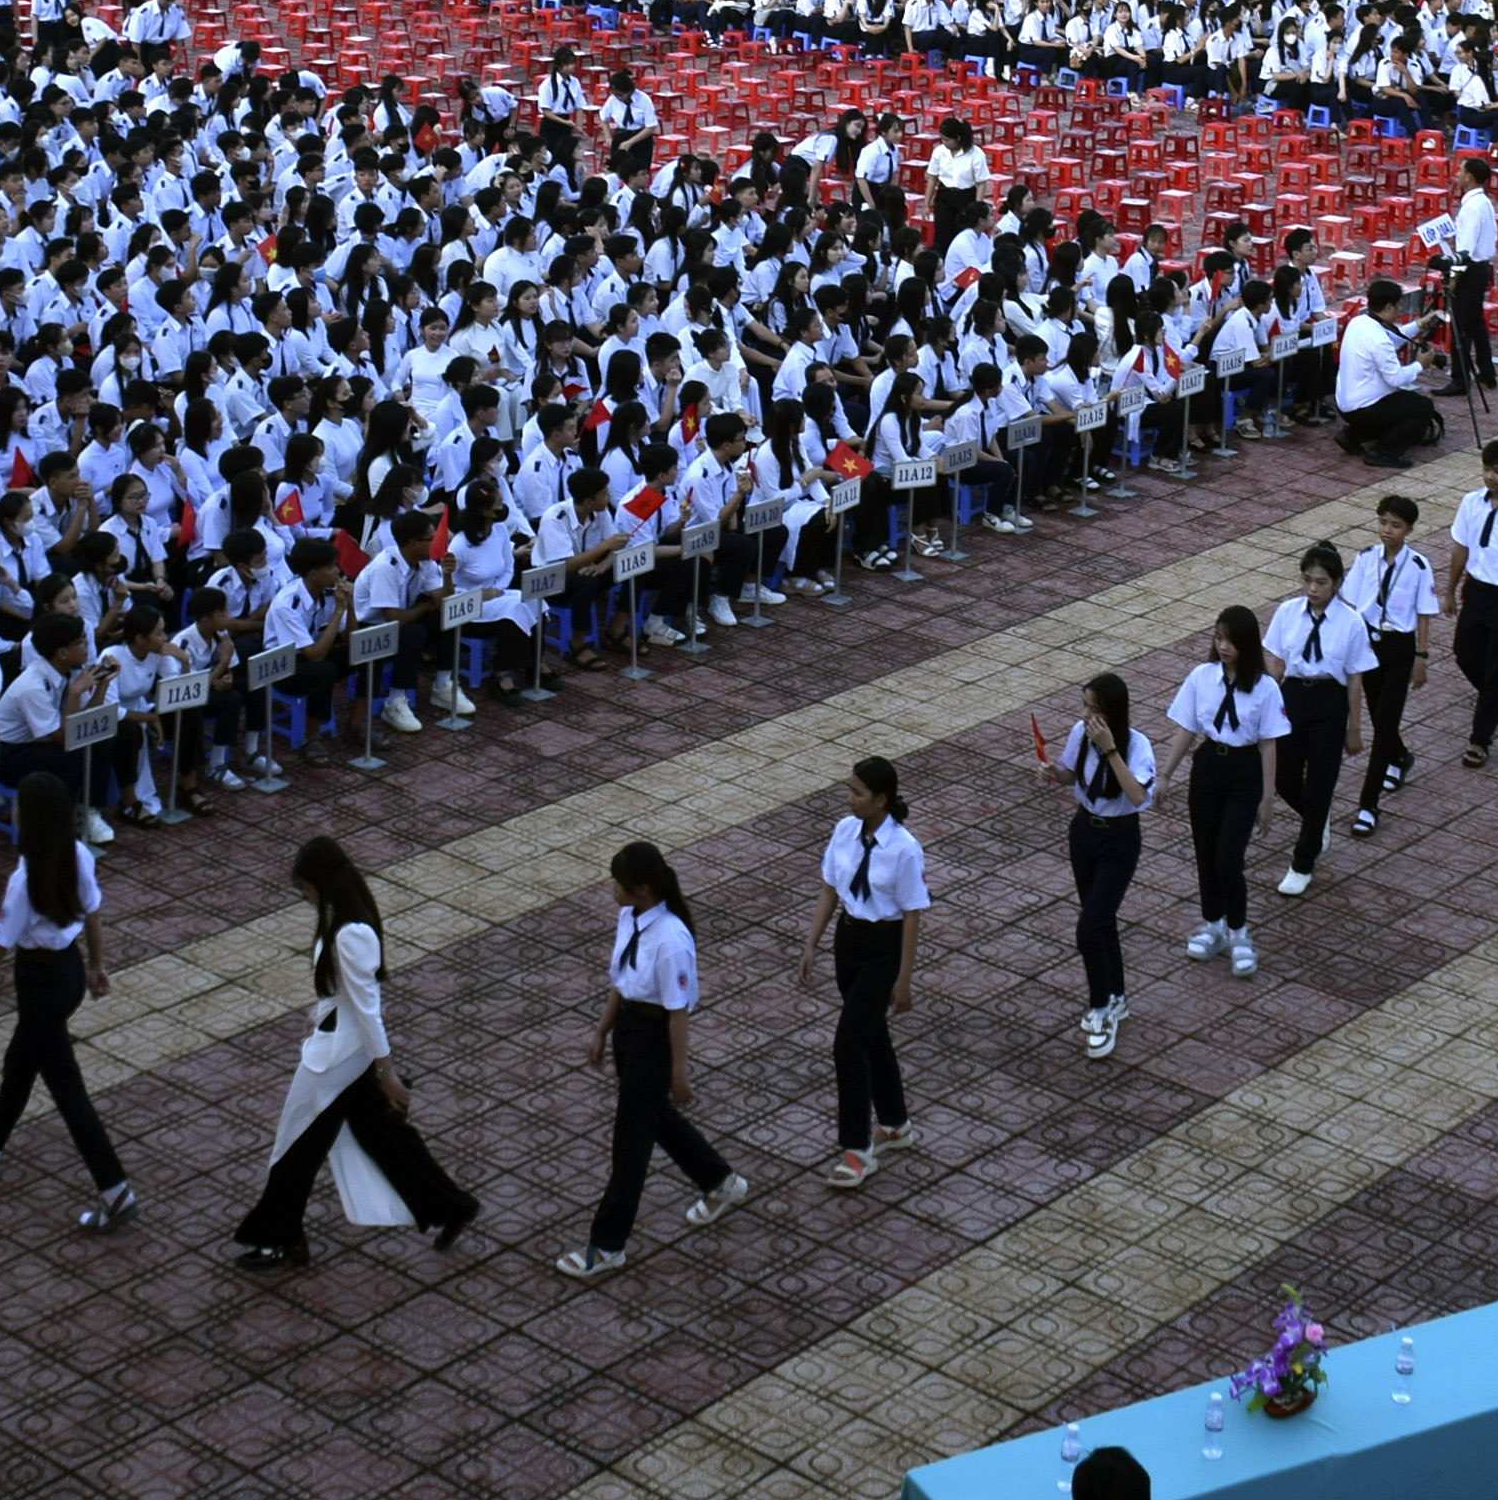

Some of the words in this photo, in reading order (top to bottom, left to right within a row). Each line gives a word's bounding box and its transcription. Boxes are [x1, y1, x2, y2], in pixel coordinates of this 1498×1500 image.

[1181, 374, 1202, 391] 11A17
[1078, 408, 1104, 427] 11A15
[899, 466, 933, 483] 11A12
[835, 486, 857, 508] 11A11
[748, 506, 779, 527] 11A10
[690, 530, 715, 550] 11A9
[621, 551, 647, 574] 11A8
[531, 573, 556, 593] 11A7
[448, 598, 474, 621] 11A6
[361, 633, 390, 656] 11A5
[258, 656, 287, 680] 11A4
[167, 682, 201, 705] 11A3
[76, 715, 109, 740] 11A2
